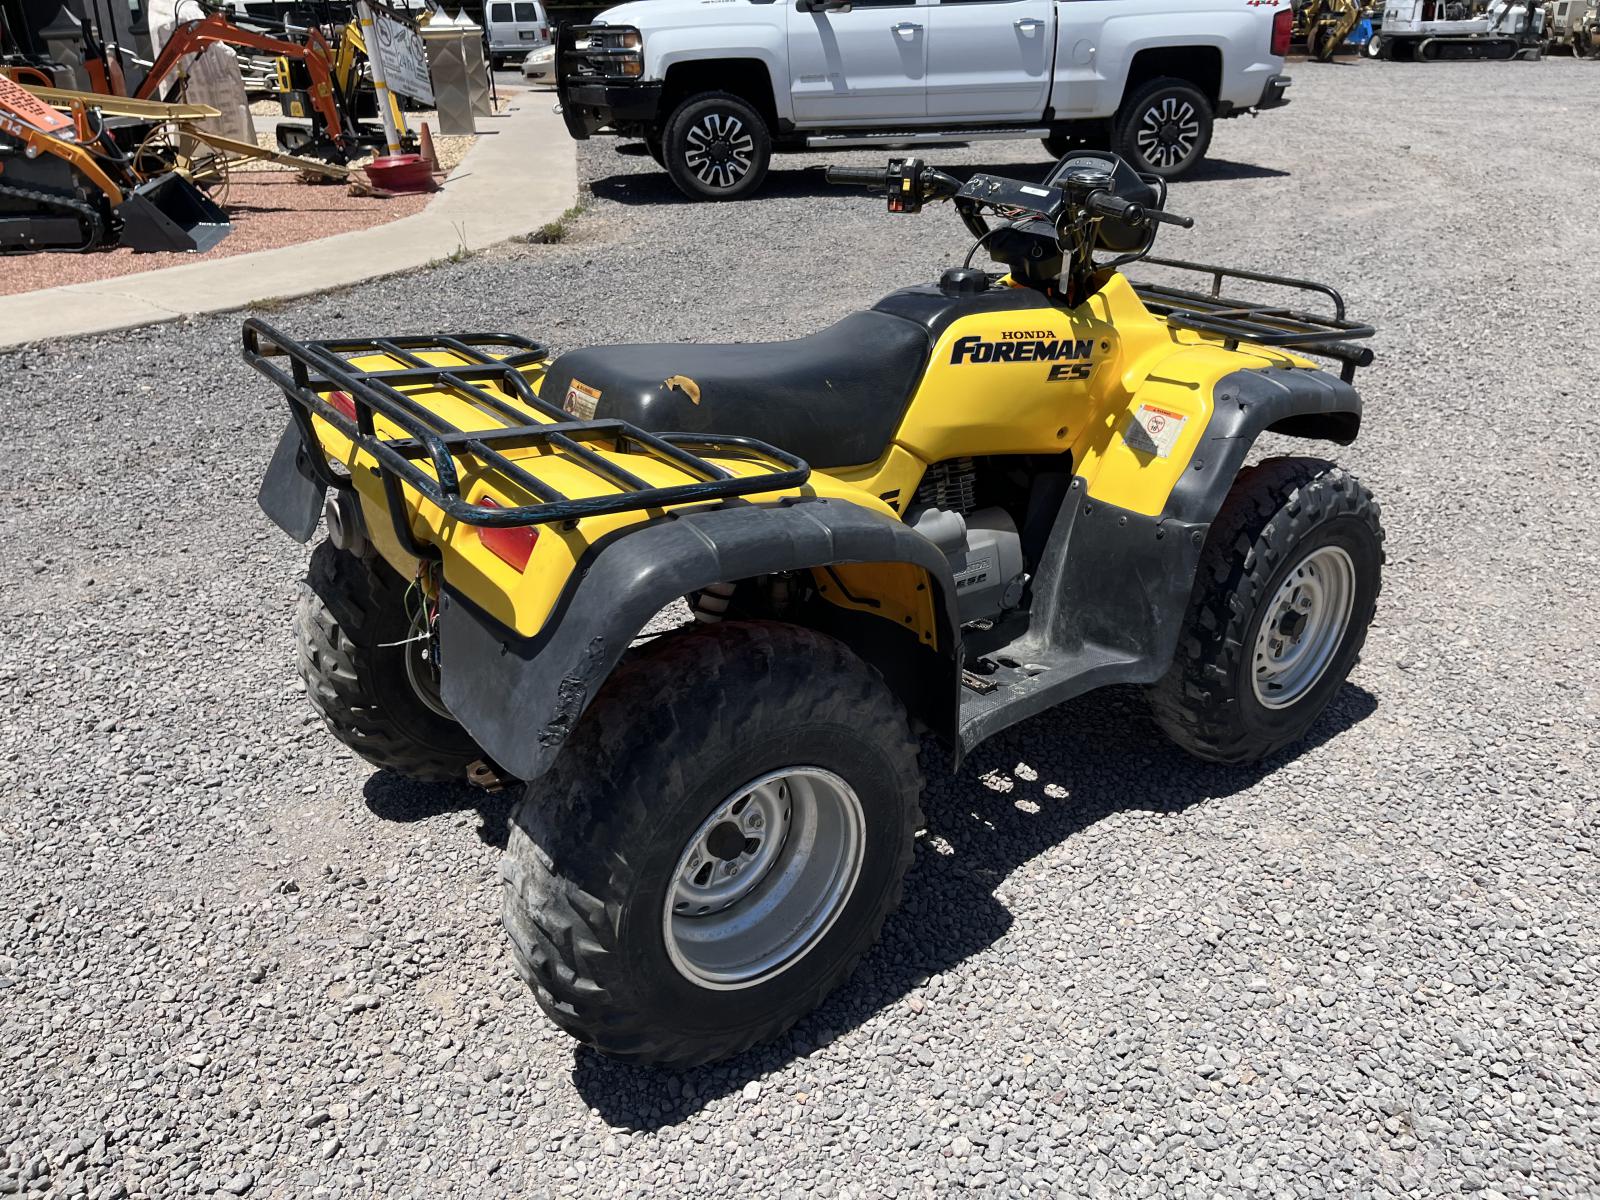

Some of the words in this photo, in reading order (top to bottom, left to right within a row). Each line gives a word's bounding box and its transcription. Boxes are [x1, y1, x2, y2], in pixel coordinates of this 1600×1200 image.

[1001, 330, 1057, 340] HONDA
[950, 335, 1094, 365] FOREMAN
[1046, 363, 1093, 382] ES
